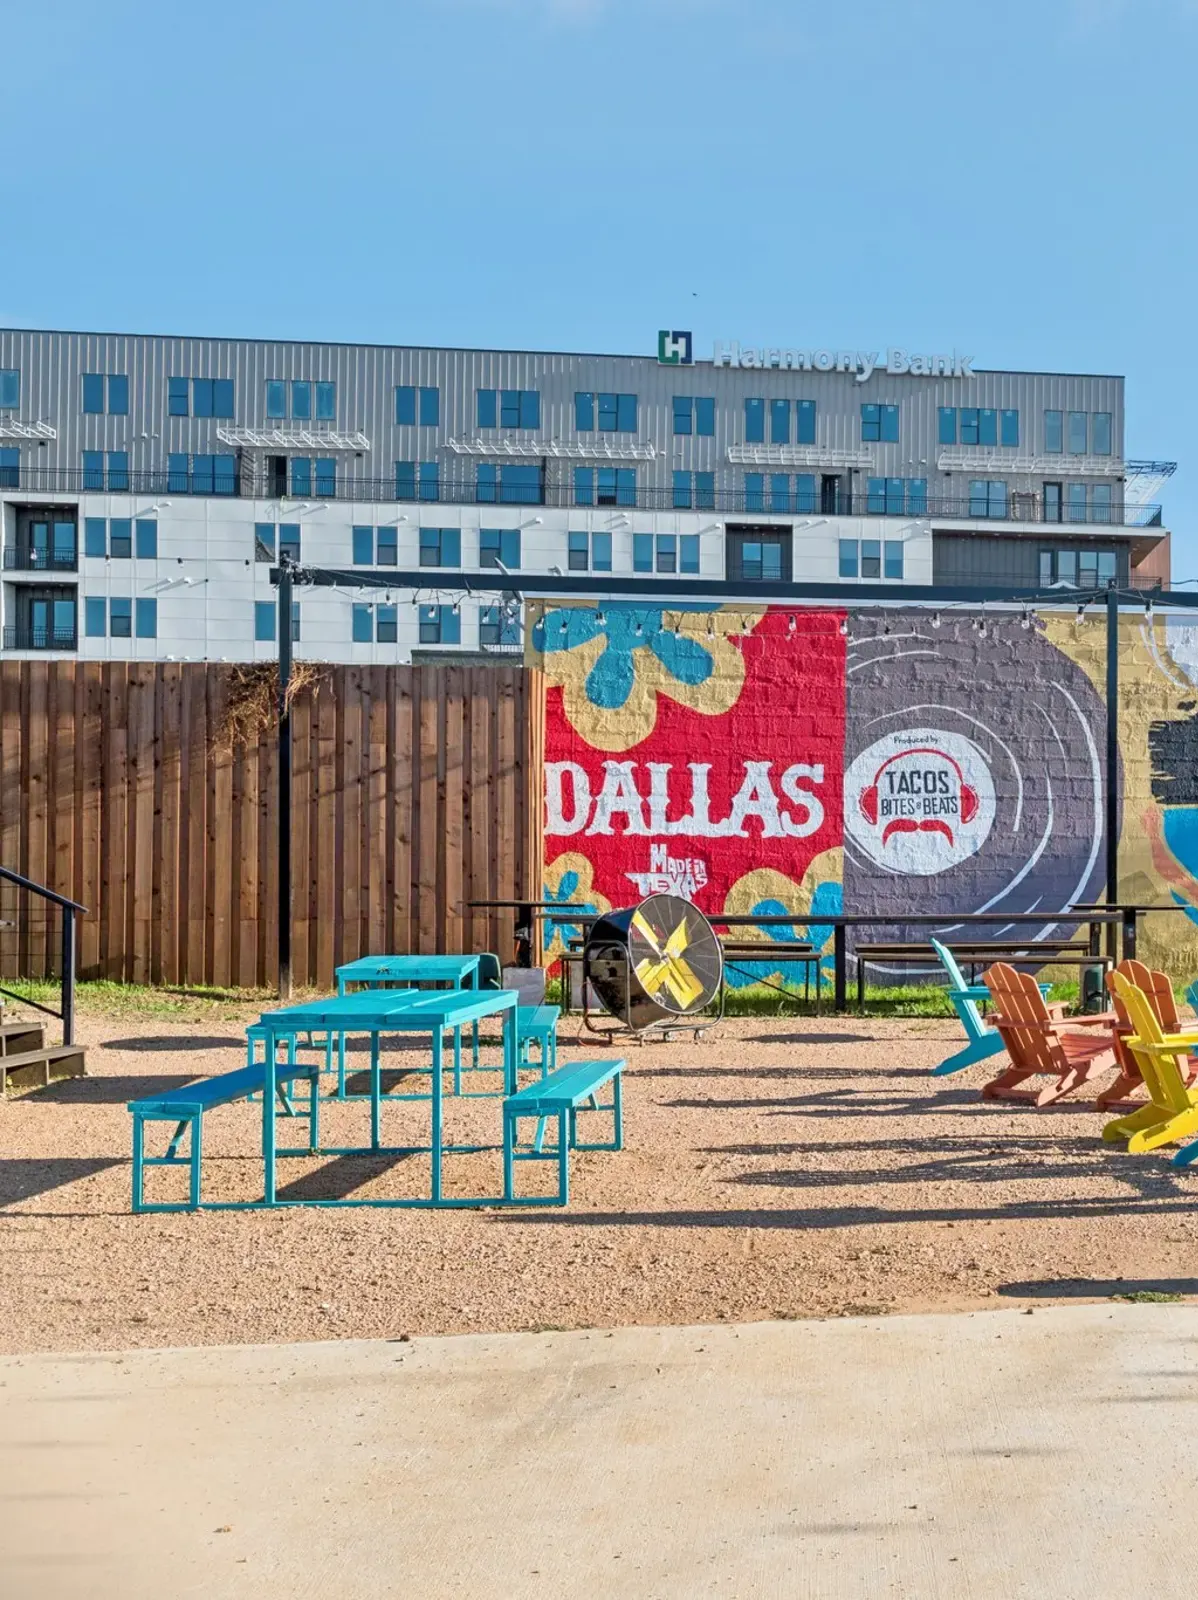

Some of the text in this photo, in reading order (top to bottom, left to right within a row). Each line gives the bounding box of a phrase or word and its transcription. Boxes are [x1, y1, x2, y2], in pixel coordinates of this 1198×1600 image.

[713, 339, 879, 382] Harmony
[887, 346, 976, 379] Bank
[893, 735, 938, 744] Produced by
[885, 770, 949, 794] TACOS
[544, 761, 824, 838] DALLAS
[881, 798, 915, 816] BITES
[924, 797, 958, 815] BEATS
